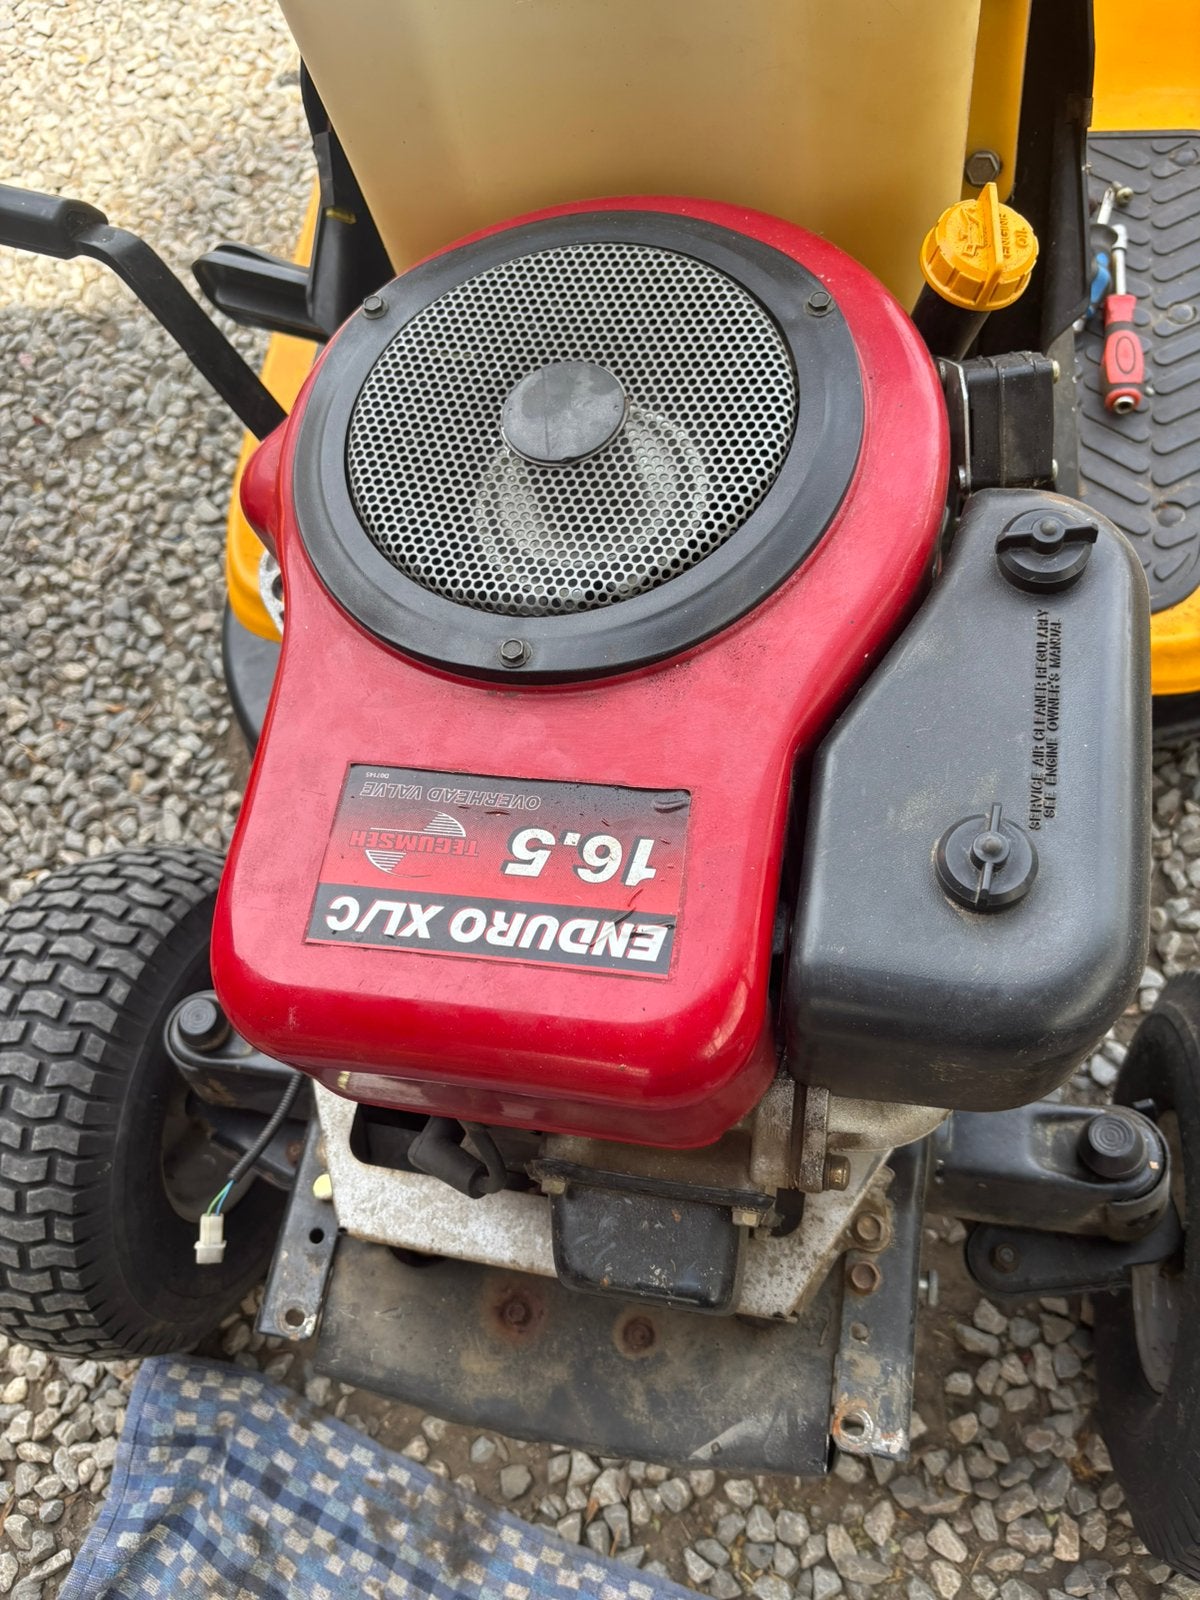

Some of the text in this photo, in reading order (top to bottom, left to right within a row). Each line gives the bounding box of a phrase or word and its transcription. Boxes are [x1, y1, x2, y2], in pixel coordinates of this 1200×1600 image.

[1029, 609, 1049, 830] SERVICE AIR CLEANER REGULARLY
[1043, 618, 1062, 819] SEE ENGINE OWNER'S MANUAL
[359, 781, 542, 811] OVERHEAD VALVE
[350, 830, 479, 858] TECUMSEH
[500, 827, 658, 886] 16.5
[325, 895, 668, 962] ENDURO XL/C
